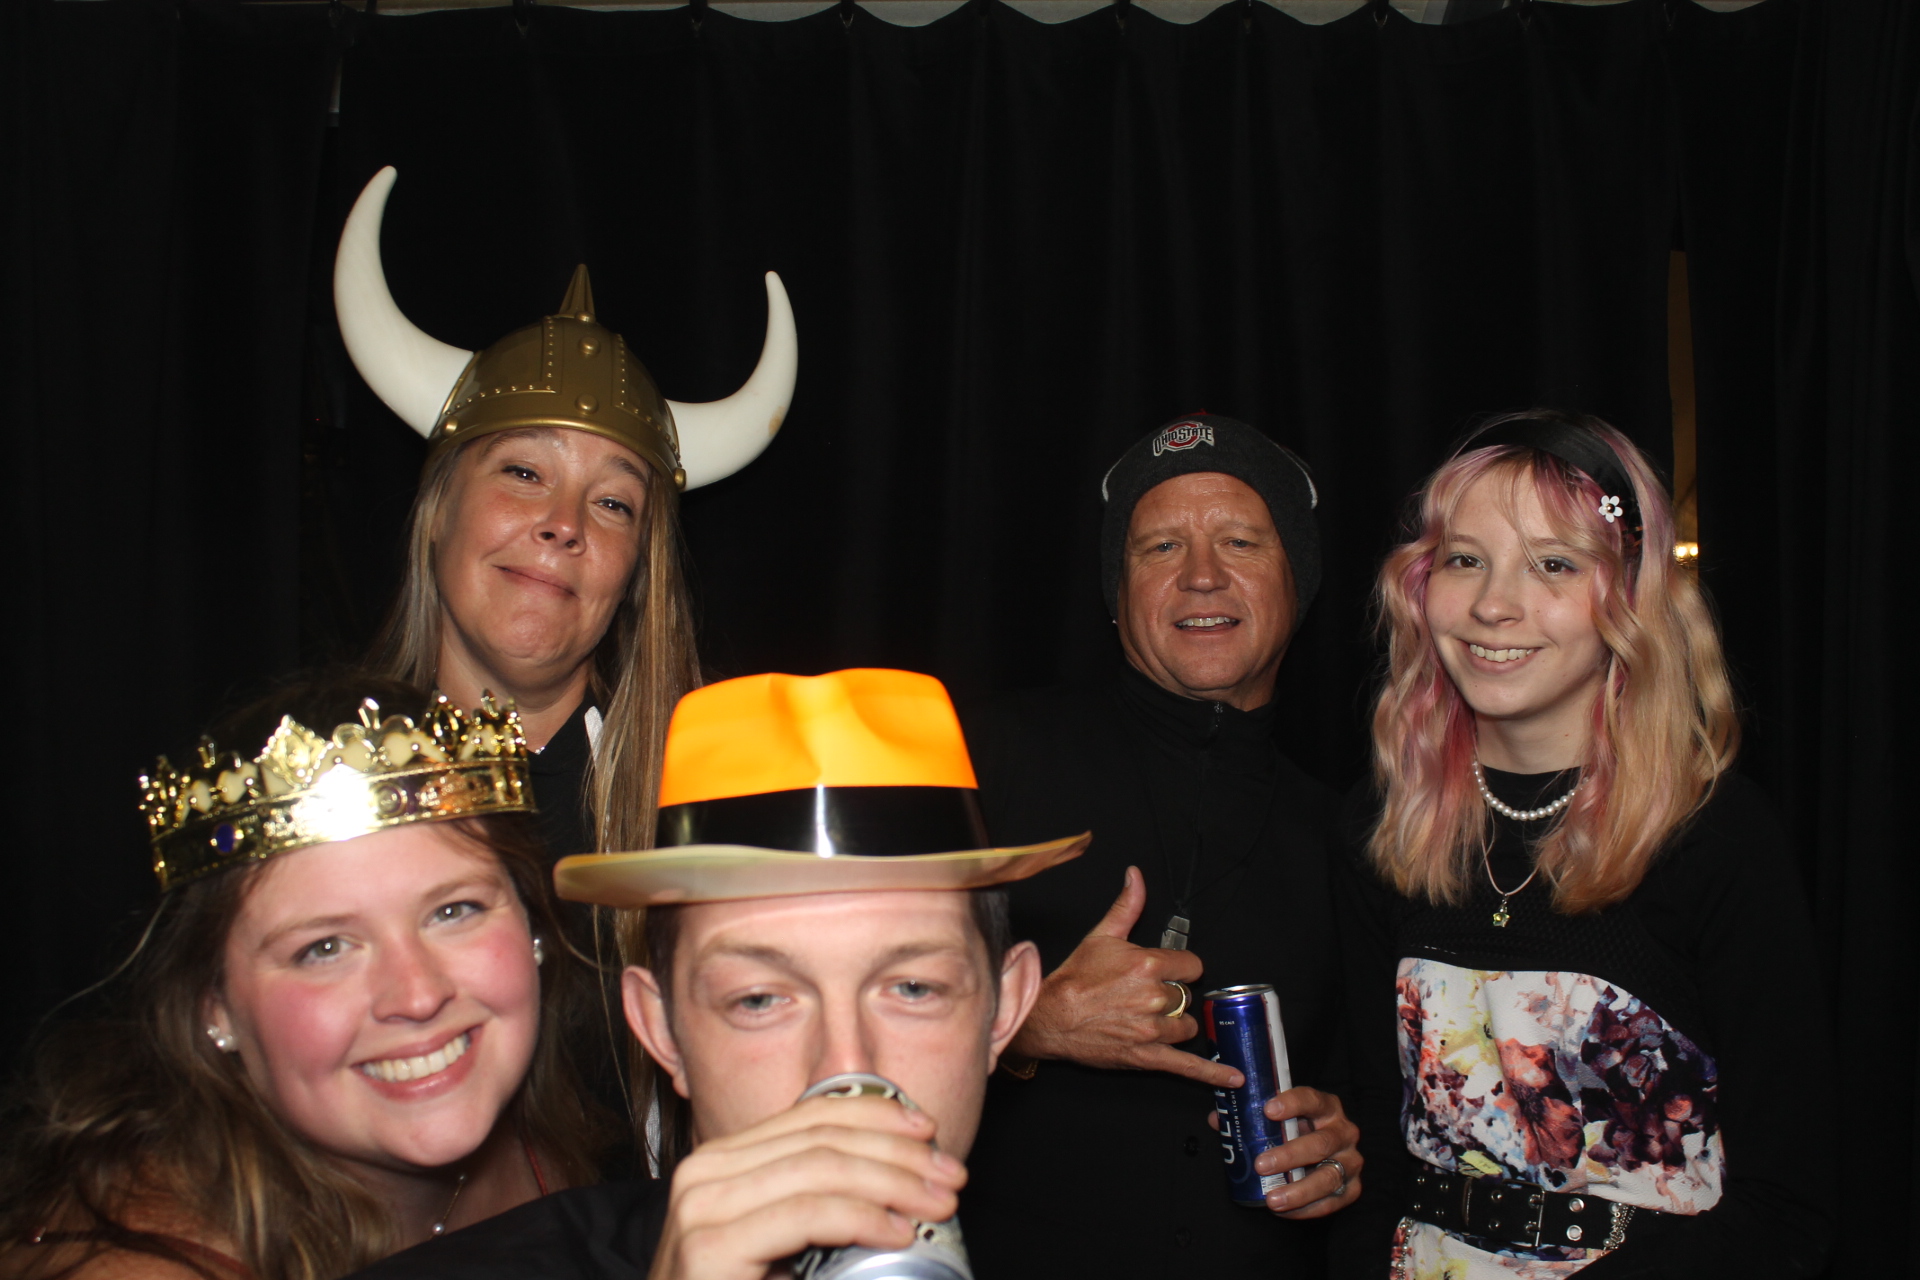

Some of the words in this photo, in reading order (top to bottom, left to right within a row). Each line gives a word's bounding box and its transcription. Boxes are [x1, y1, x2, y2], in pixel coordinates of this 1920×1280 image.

[1154, 430, 1177, 454] OHIO
[1178, 427, 1213, 442] STATE
[1234, 1115, 1243, 1152] SUPERIOR
